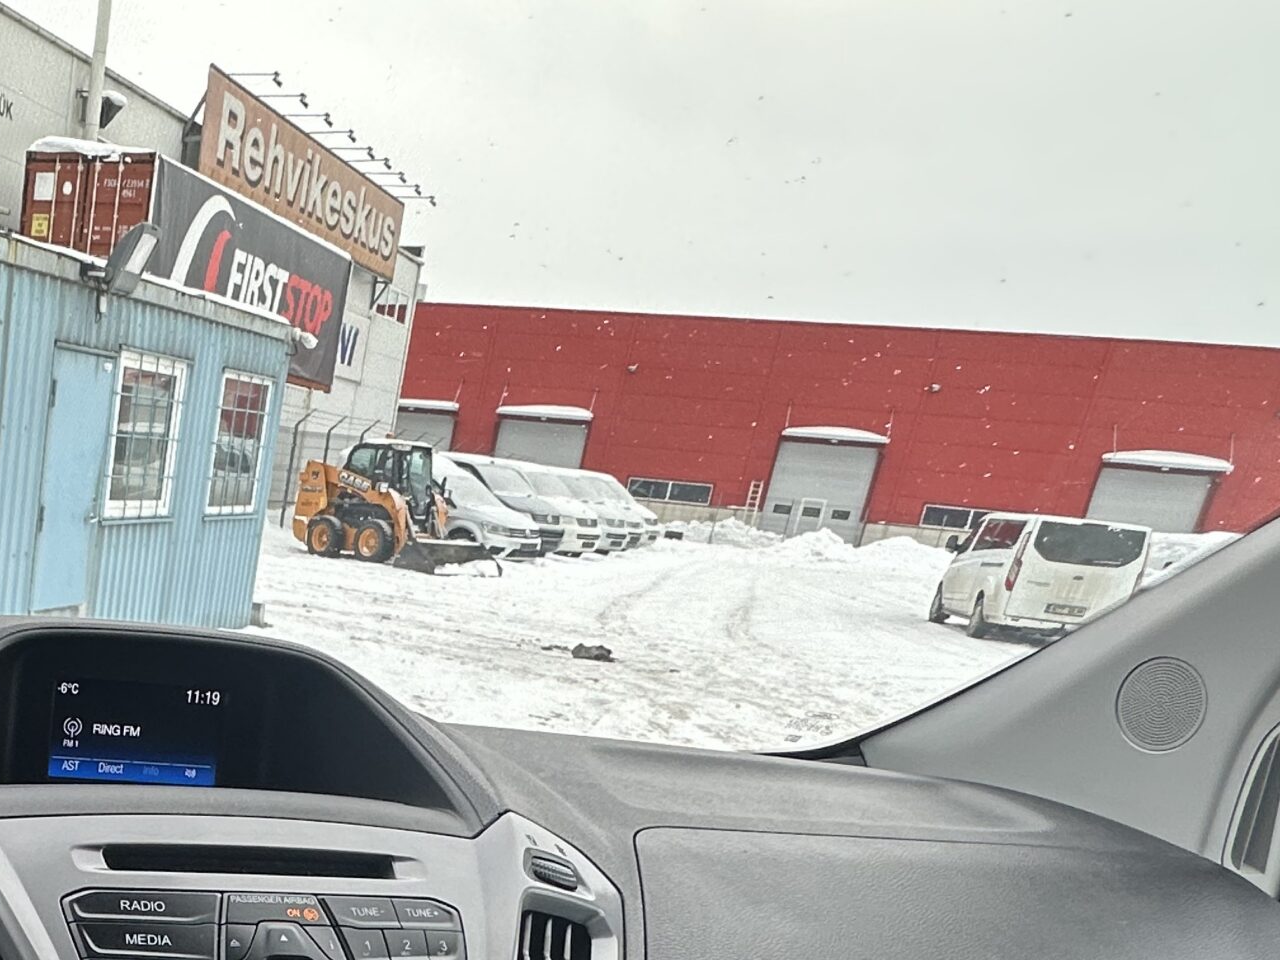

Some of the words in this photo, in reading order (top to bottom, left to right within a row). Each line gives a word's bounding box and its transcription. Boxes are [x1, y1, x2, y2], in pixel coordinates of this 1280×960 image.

[216, 91, 395, 260] Rehvikeskus
[57, 682, 79, 695] -6°C
[186, 690, 220, 706] 11:19
[92, 723, 120, 736] RING
[123, 726, 141, 737] FM
[61, 760, 80, 771] AST
[98, 762, 124, 774] Direct
[120, 900, 166, 912] RADIO
[125, 934, 172, 946] MEDIA
[402, 940, 412, 950] 2
[439, 941, 448, 951] 3
